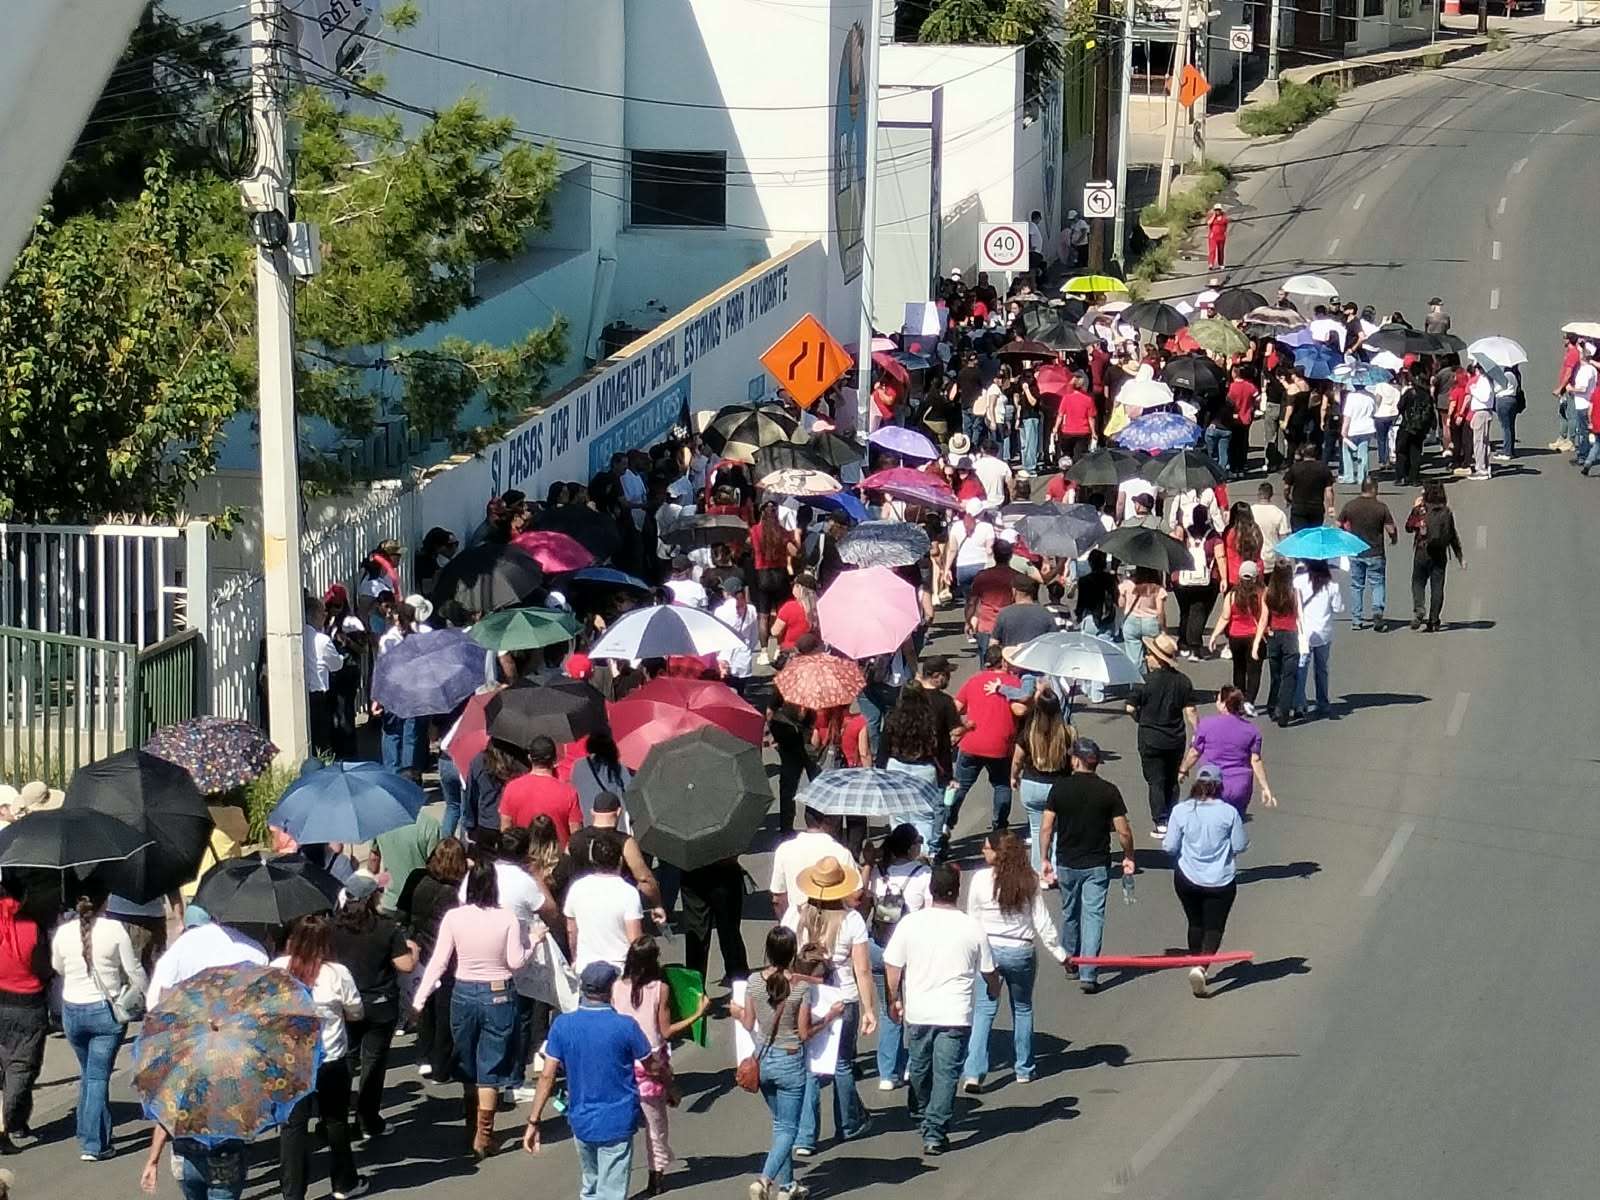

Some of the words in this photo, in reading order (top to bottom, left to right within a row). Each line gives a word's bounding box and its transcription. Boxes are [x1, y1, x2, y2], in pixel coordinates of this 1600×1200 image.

[993, 236, 1015, 251] 40
[491, 447, 502, 497] SI
[508, 421, 544, 489] PASAS
[550, 404, 570, 461] POR
[576, 391, 591, 443] UN
[595, 355, 647, 430] MOMENTO
[683, 306, 722, 369] ESTAMOS
[725, 291, 745, 340] PARA
[748, 264, 788, 324] AYUDARTE
